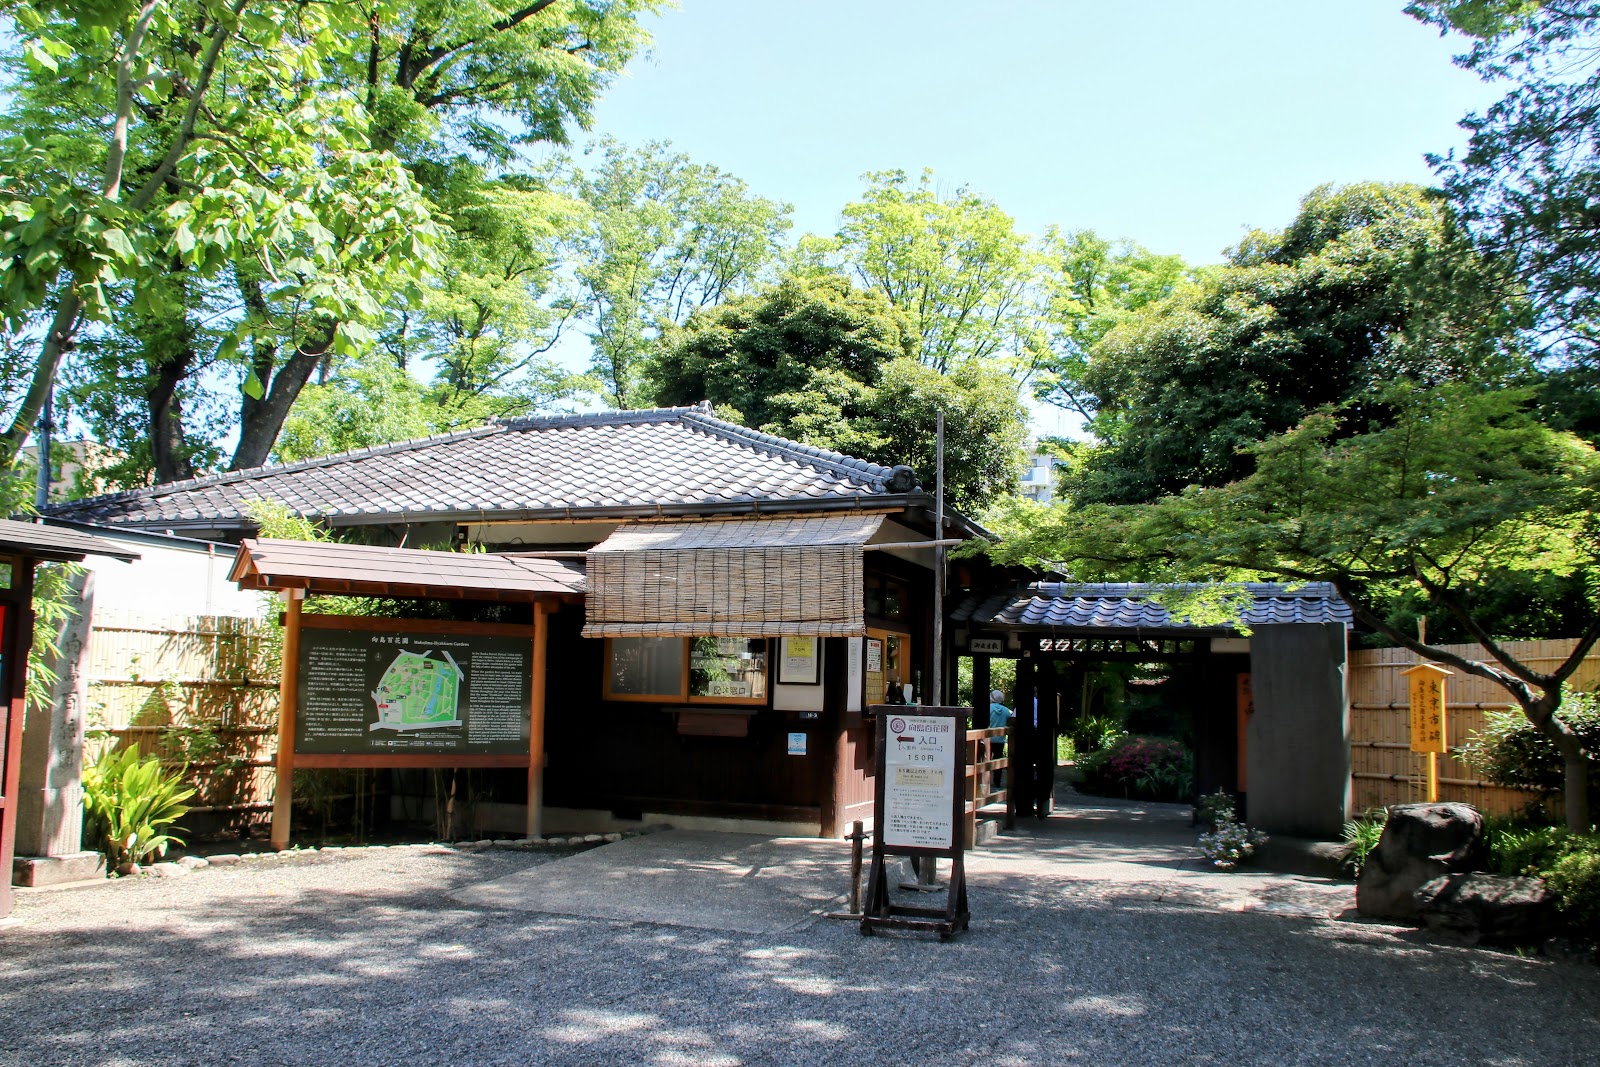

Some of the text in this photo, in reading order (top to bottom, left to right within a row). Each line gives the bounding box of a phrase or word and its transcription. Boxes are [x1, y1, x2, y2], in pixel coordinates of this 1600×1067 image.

[371, 636, 409, 645] 向島百花園
[908, 724, 949, 733] 向島百花園
[918, 736, 937, 745] 入口
[908, 754, 934, 762] 150円
